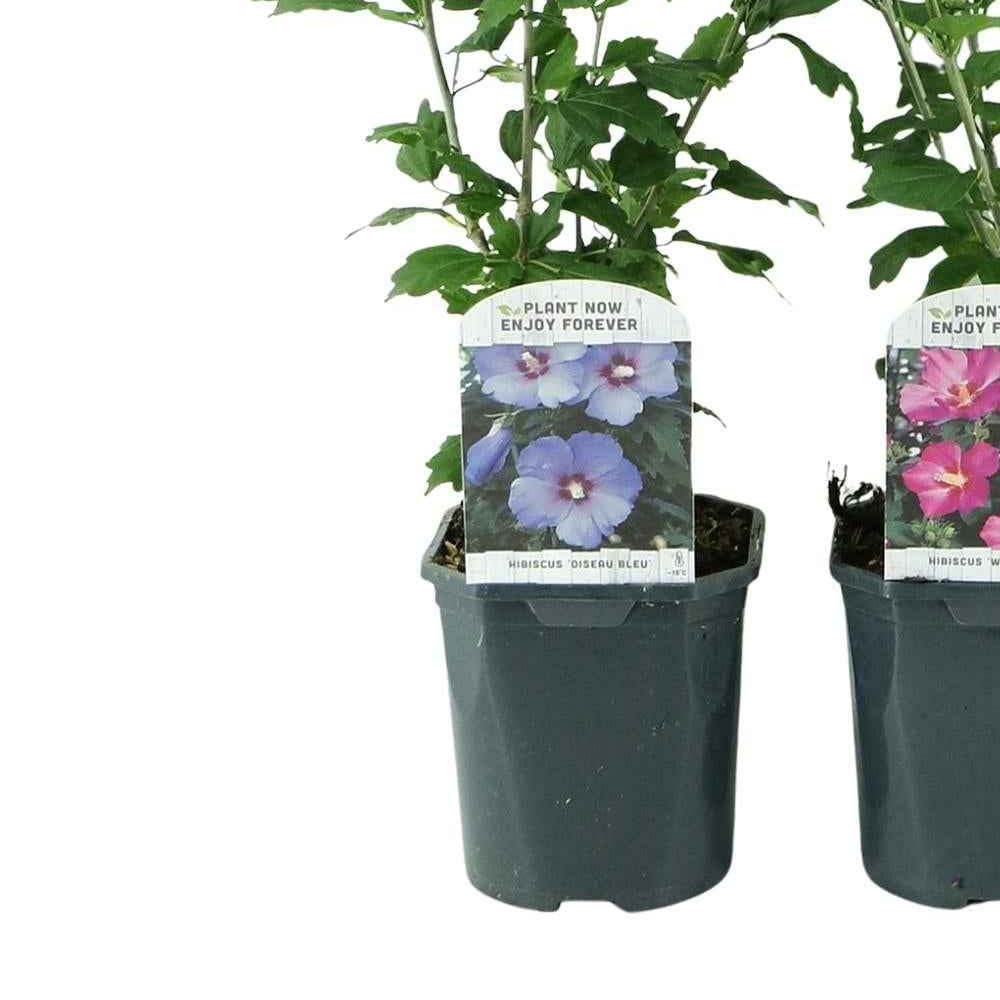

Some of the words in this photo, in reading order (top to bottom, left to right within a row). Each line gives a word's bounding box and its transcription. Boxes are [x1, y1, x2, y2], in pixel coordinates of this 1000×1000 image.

[525, 302, 578, 313] PLANT
[585, 302, 622, 313] NOW
[501, 319, 556, 331] ENJOY
[563, 318, 638, 330] FOREVER
[931, 322, 985, 334] ENJOY
[509, 560, 562, 568] HIBISCUS
[929, 557, 982, 566] HIBISCUS
